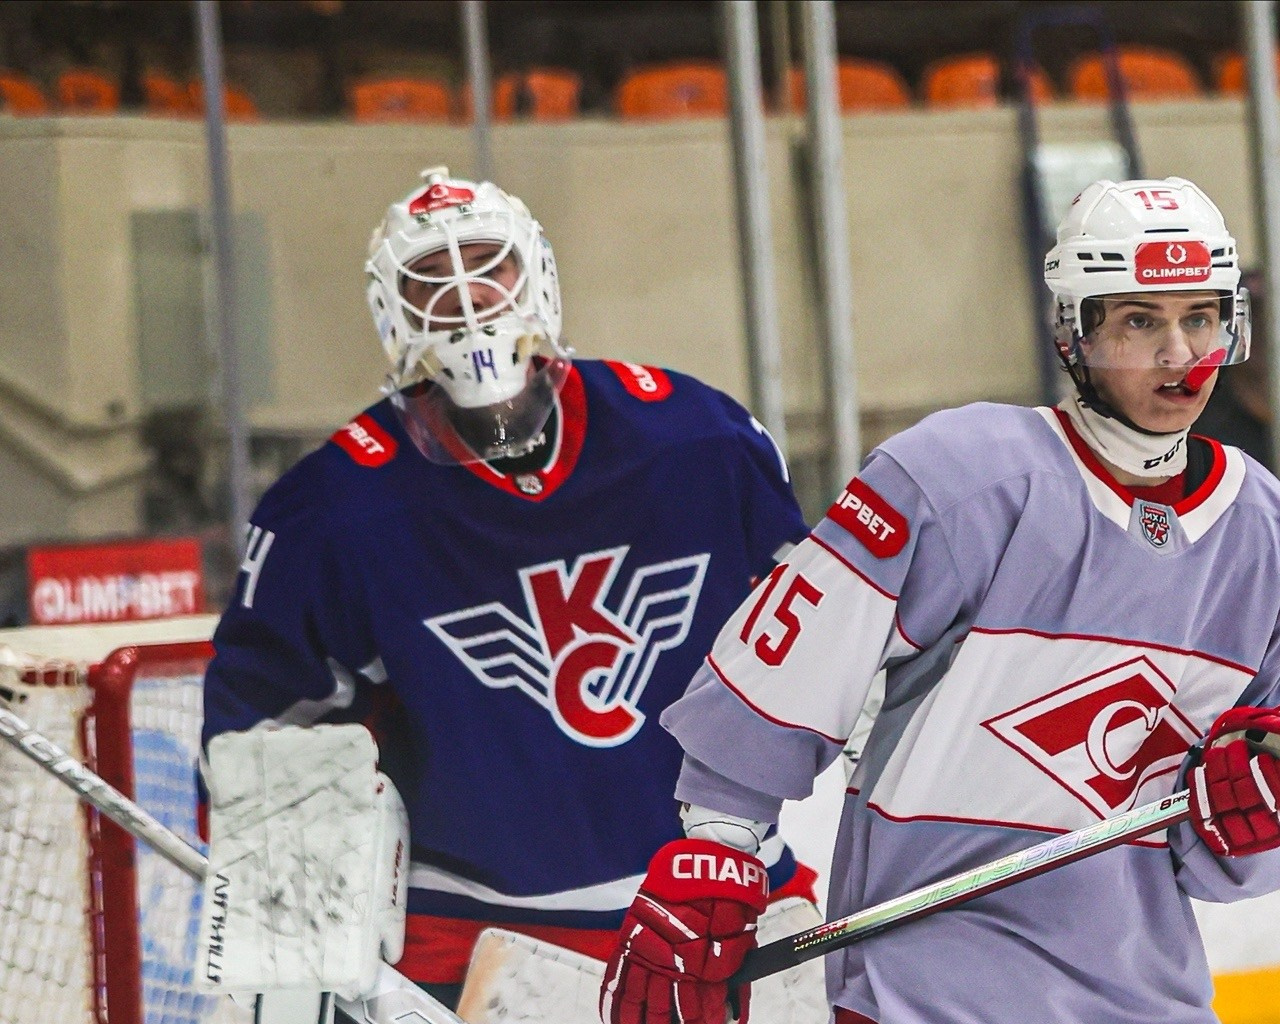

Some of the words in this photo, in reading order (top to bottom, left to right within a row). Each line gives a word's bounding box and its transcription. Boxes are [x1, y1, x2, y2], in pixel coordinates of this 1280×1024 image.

[1135, 190, 1179, 210] 15
[1142, 265, 1210, 279] OLIMPBET
[472, 348, 498, 383] 14
[240, 522, 276, 609] 4
[738, 562, 827, 669] 15
